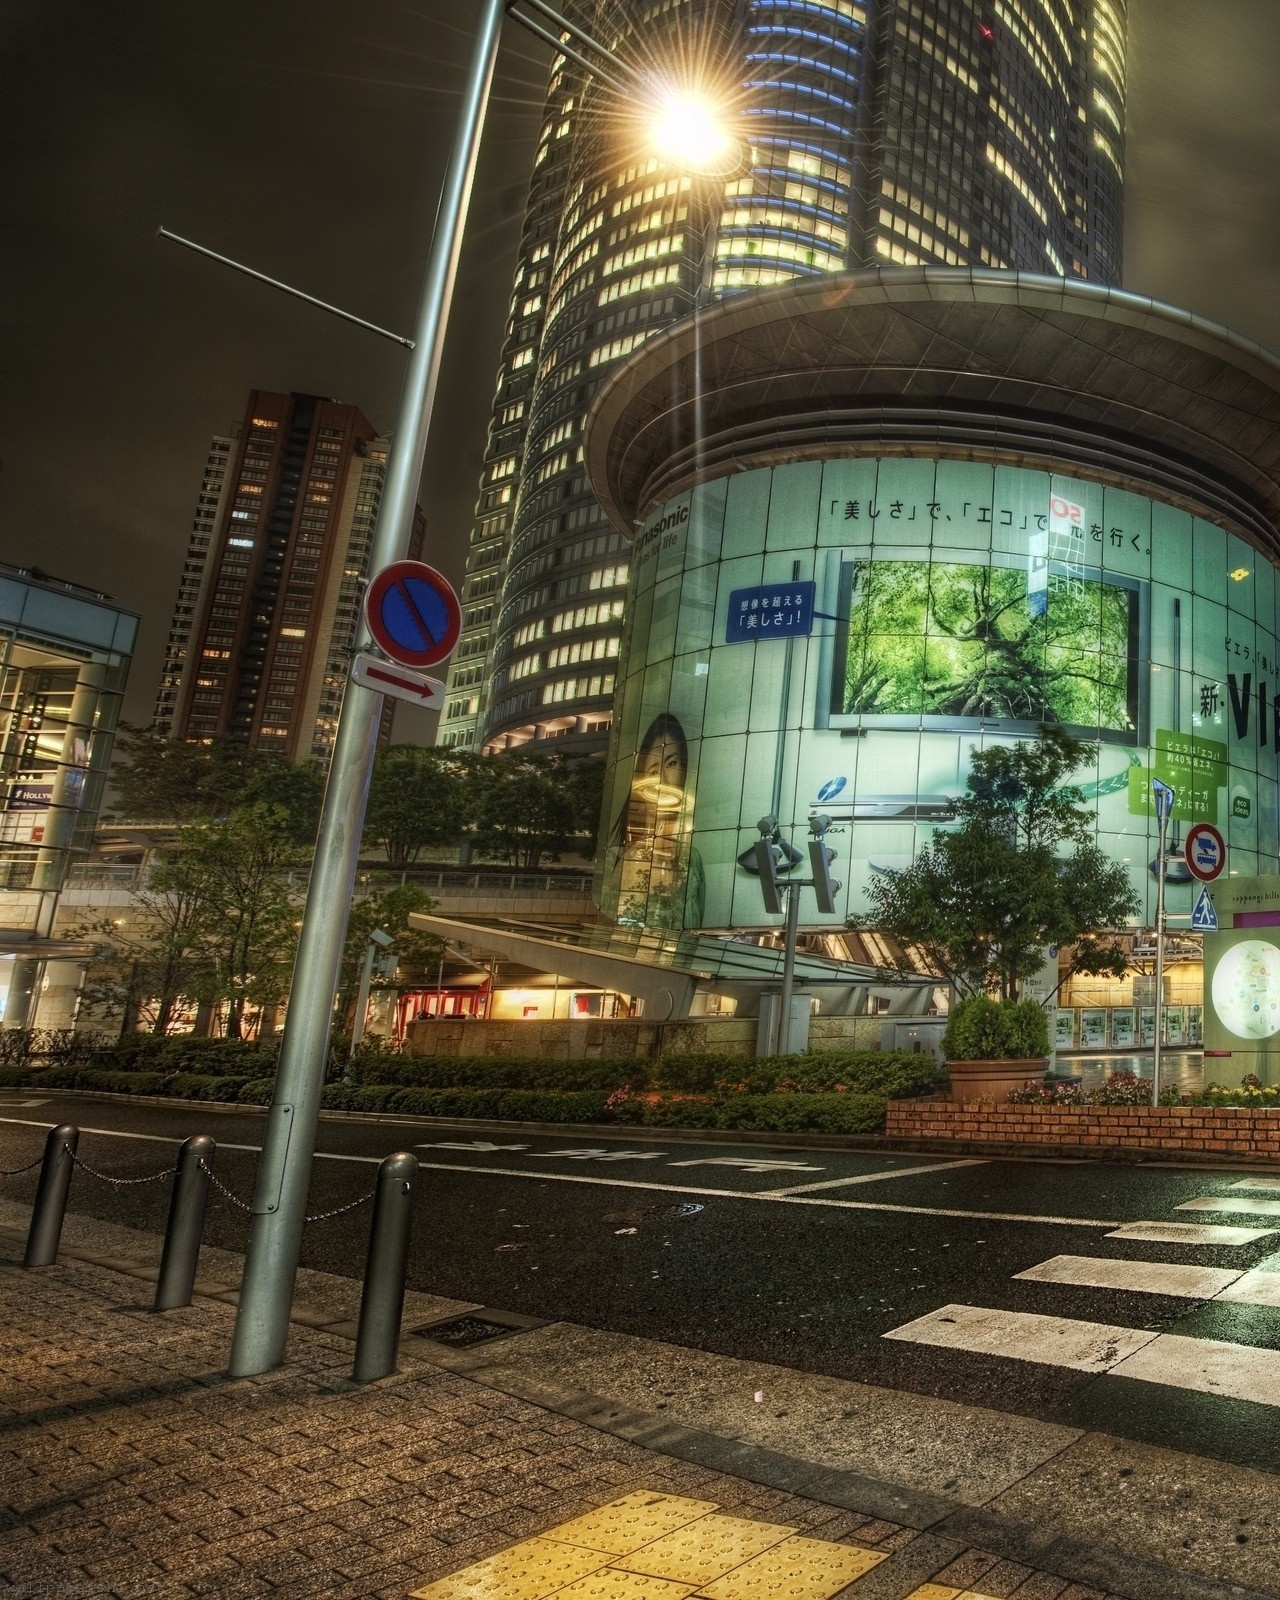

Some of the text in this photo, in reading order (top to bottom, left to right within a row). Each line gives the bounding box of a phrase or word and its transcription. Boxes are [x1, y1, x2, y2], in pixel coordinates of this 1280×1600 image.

[663, 534, 678, 550] life
[740, 595, 803, 611] 想像を超える
[739, 610, 801, 629] 「美しさ」!
[1234, 805, 1250, 816] ideas
[1236, 799, 1248, 808] eco
[1232, 891, 1280, 905] roppongi hills
